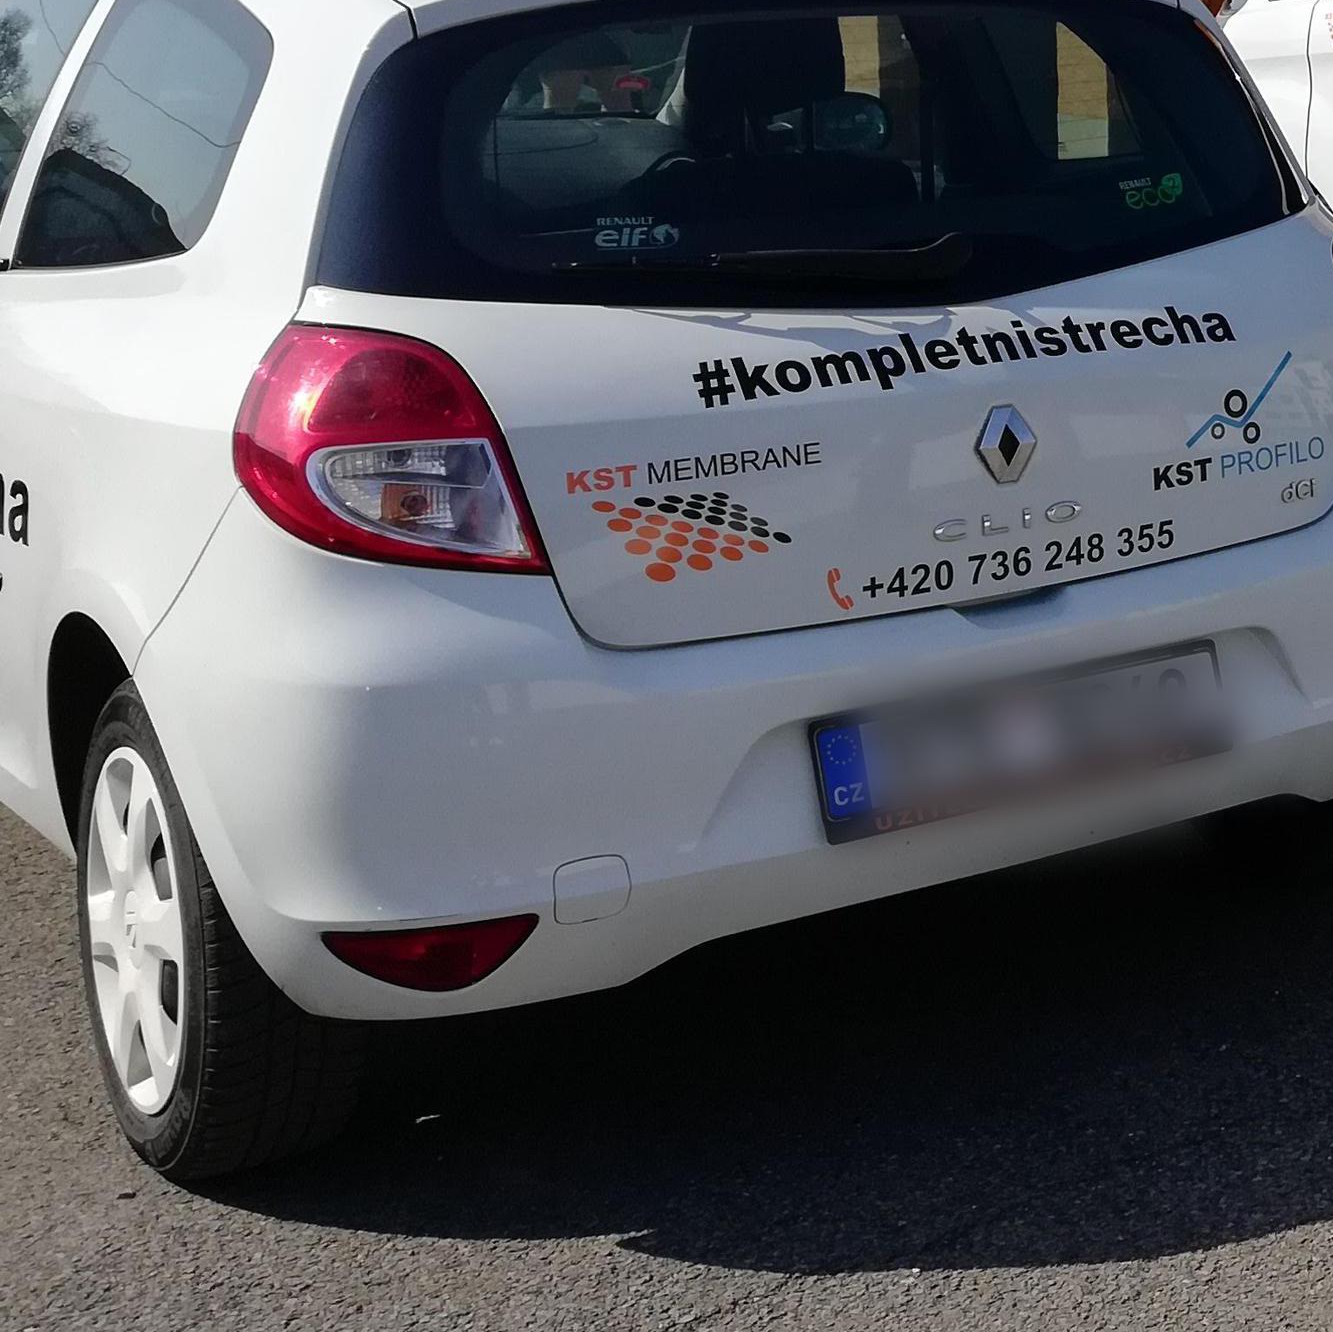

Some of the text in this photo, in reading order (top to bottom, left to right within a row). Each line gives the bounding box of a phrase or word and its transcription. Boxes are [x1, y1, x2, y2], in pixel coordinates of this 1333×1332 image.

[594, 227, 649, 247] elf
[596, 216, 655, 226] RENAULT
[692, 305, 1237, 409] #kompletnistrecha
[566, 442, 823, 494] KST MEMBRANE
[1153, 436, 1325, 491] KST PROFILO
[932, 499, 1083, 542] CLIO
[862, 519, 1175, 598] +420 736 248 355
[832, 782, 865, 807] CZ
